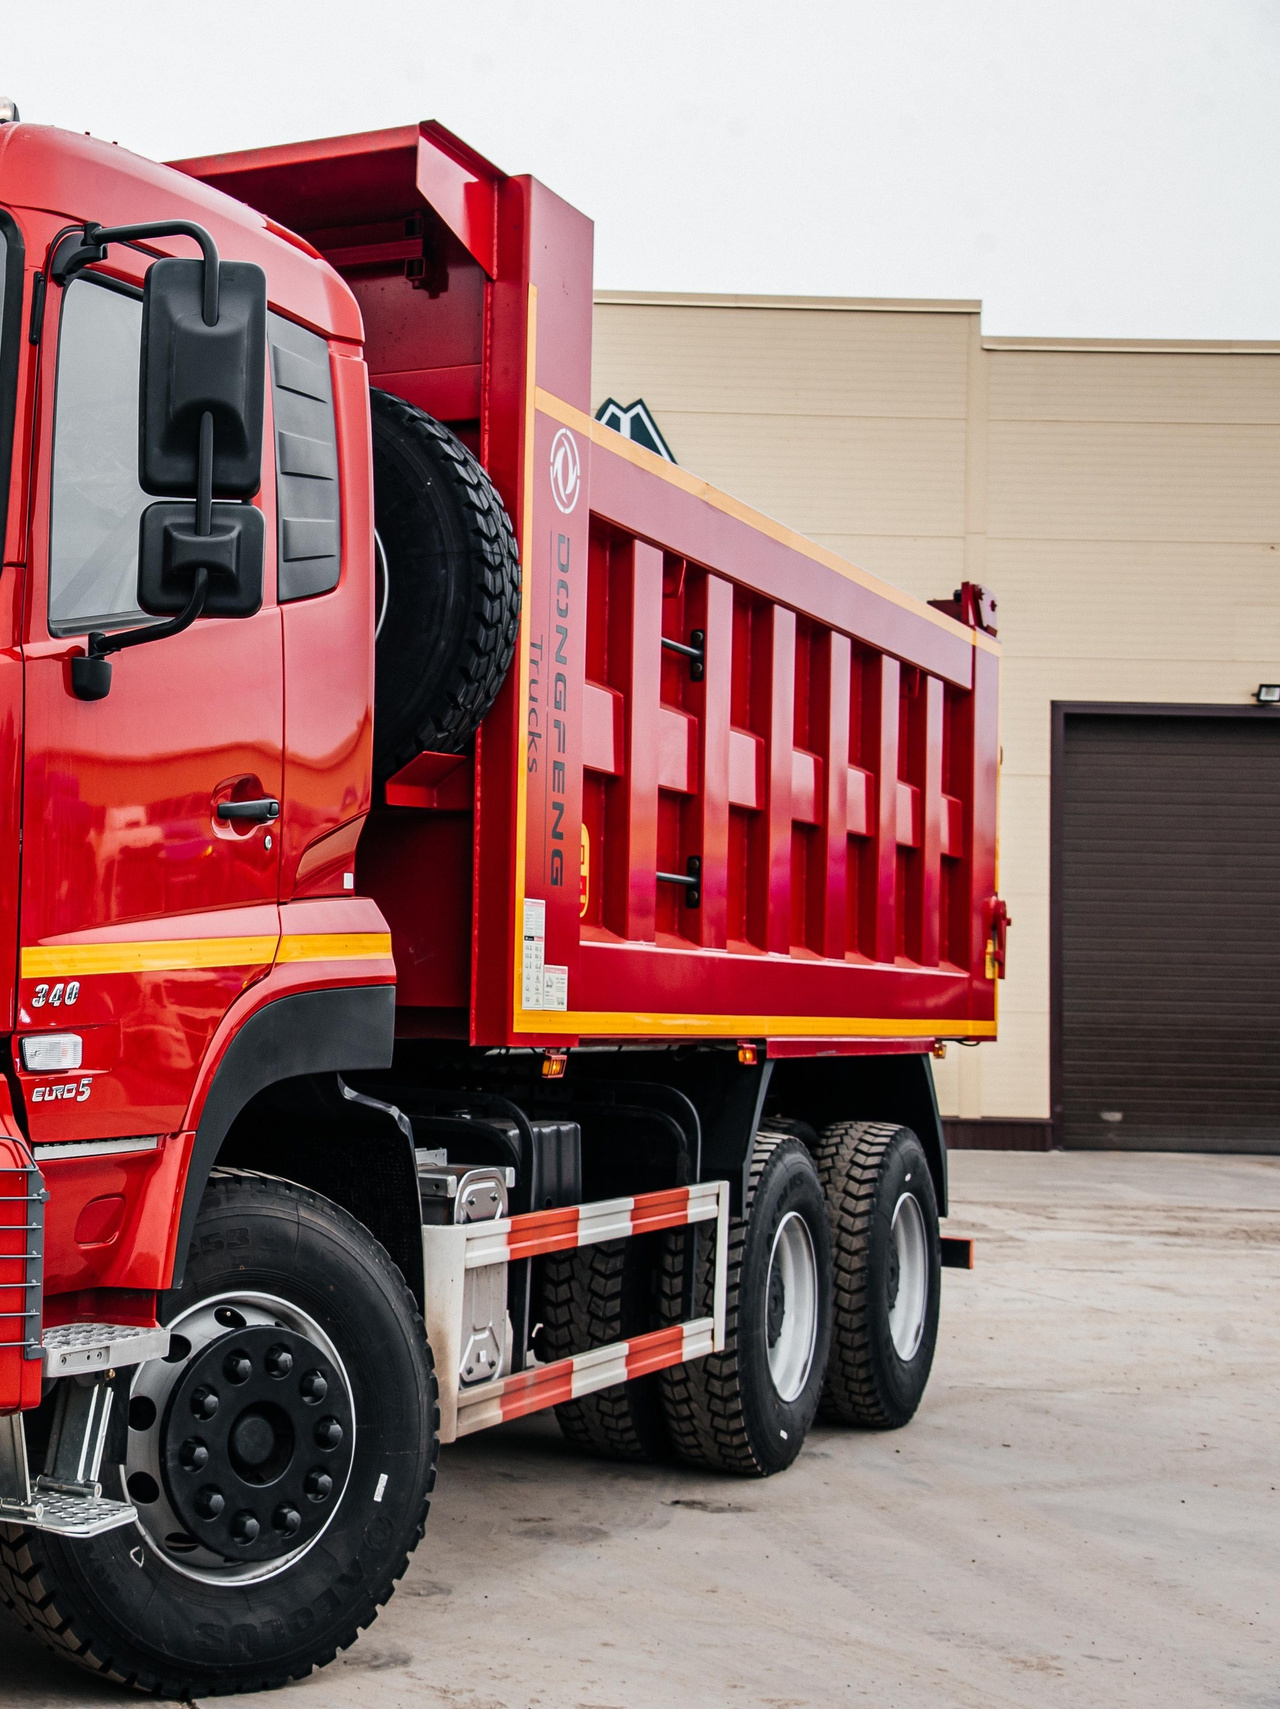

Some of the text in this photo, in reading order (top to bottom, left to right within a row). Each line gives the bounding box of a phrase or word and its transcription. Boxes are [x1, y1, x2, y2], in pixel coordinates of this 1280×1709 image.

[526, 633, 544, 774] Trucks
[549, 532, 570, 888] DONGFENG
[31, 980, 81, 1008] 340
